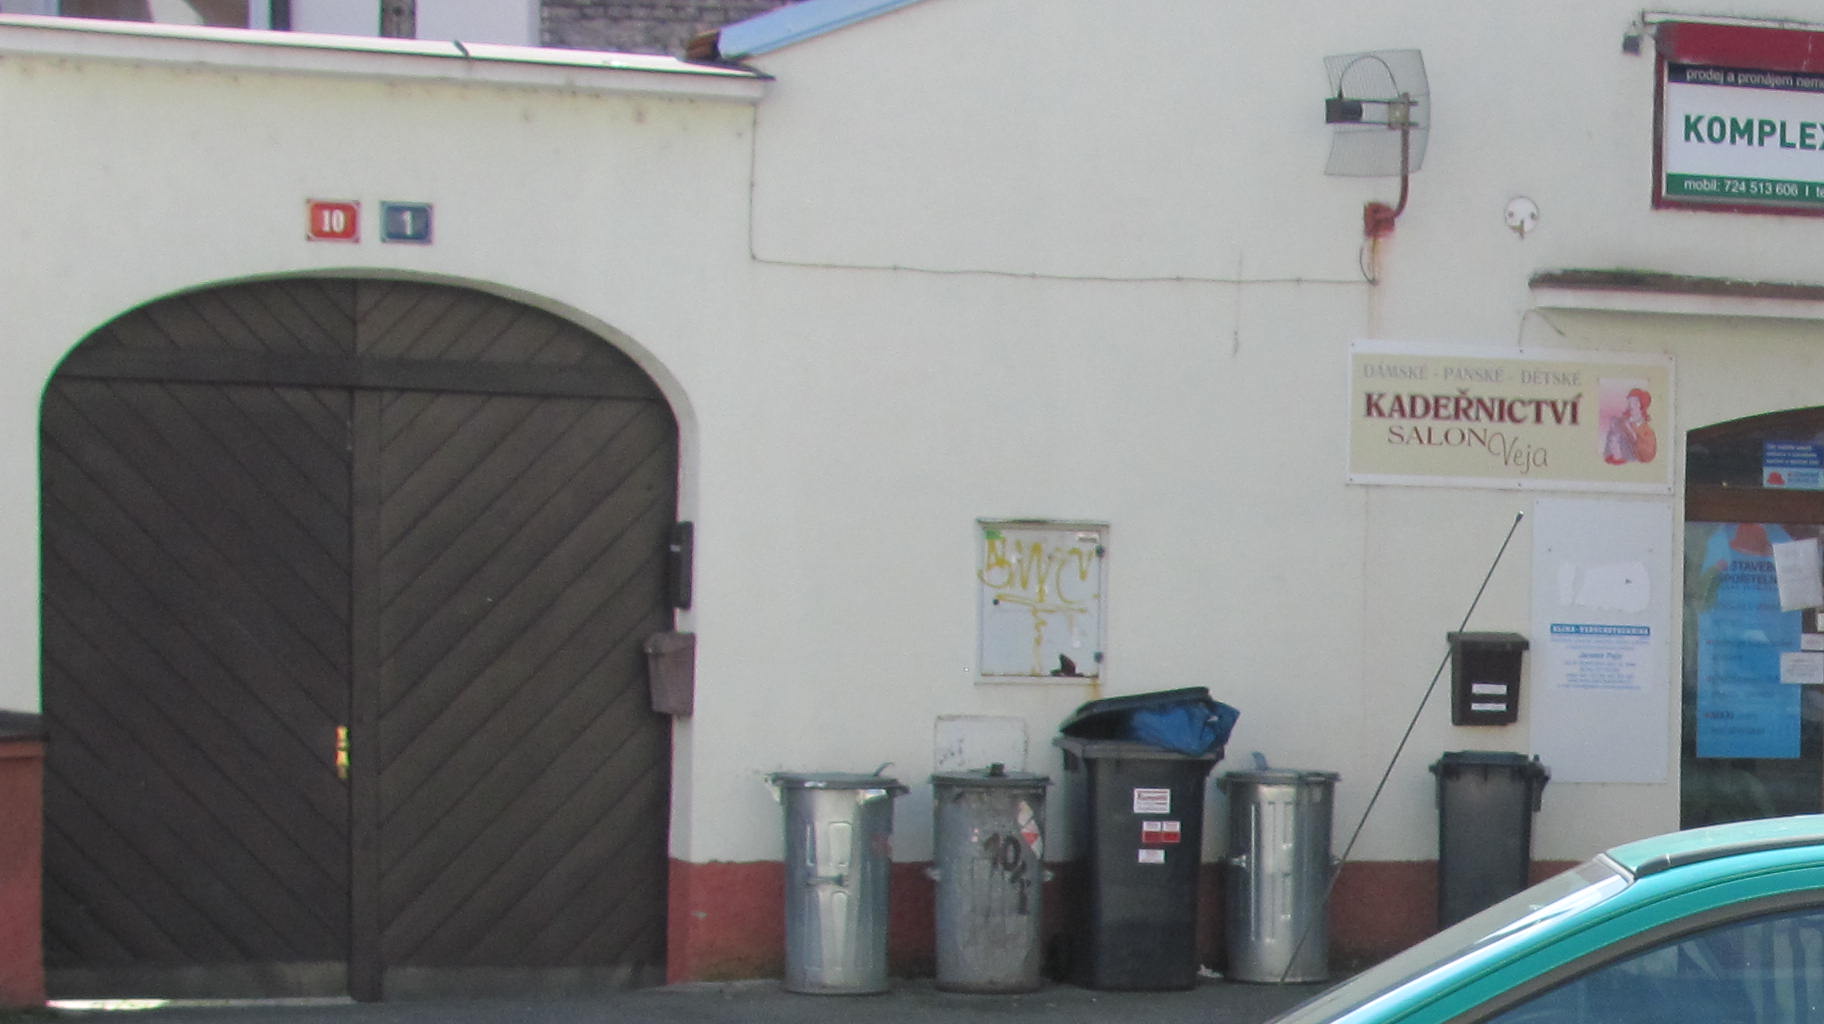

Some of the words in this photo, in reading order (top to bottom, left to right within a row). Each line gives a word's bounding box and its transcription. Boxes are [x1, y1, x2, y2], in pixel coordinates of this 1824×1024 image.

[1686, 69, 1725, 85] prodej
[1727, 74, 1735, 84] a
[1738, 72, 1793, 88] pronájem
[1684, 178, 1720, 192] mobil:
[1724, 180, 1746, 194] 724
[1750, 181, 1772, 196] 513
[322, 209, 345, 233] 10
[402, 210, 412, 235] 1
[1364, 388, 1583, 426] KADEŘNICTVÍ
[1387, 425, 1488, 448] SALON
[1487, 431, 1548, 474] Veja
